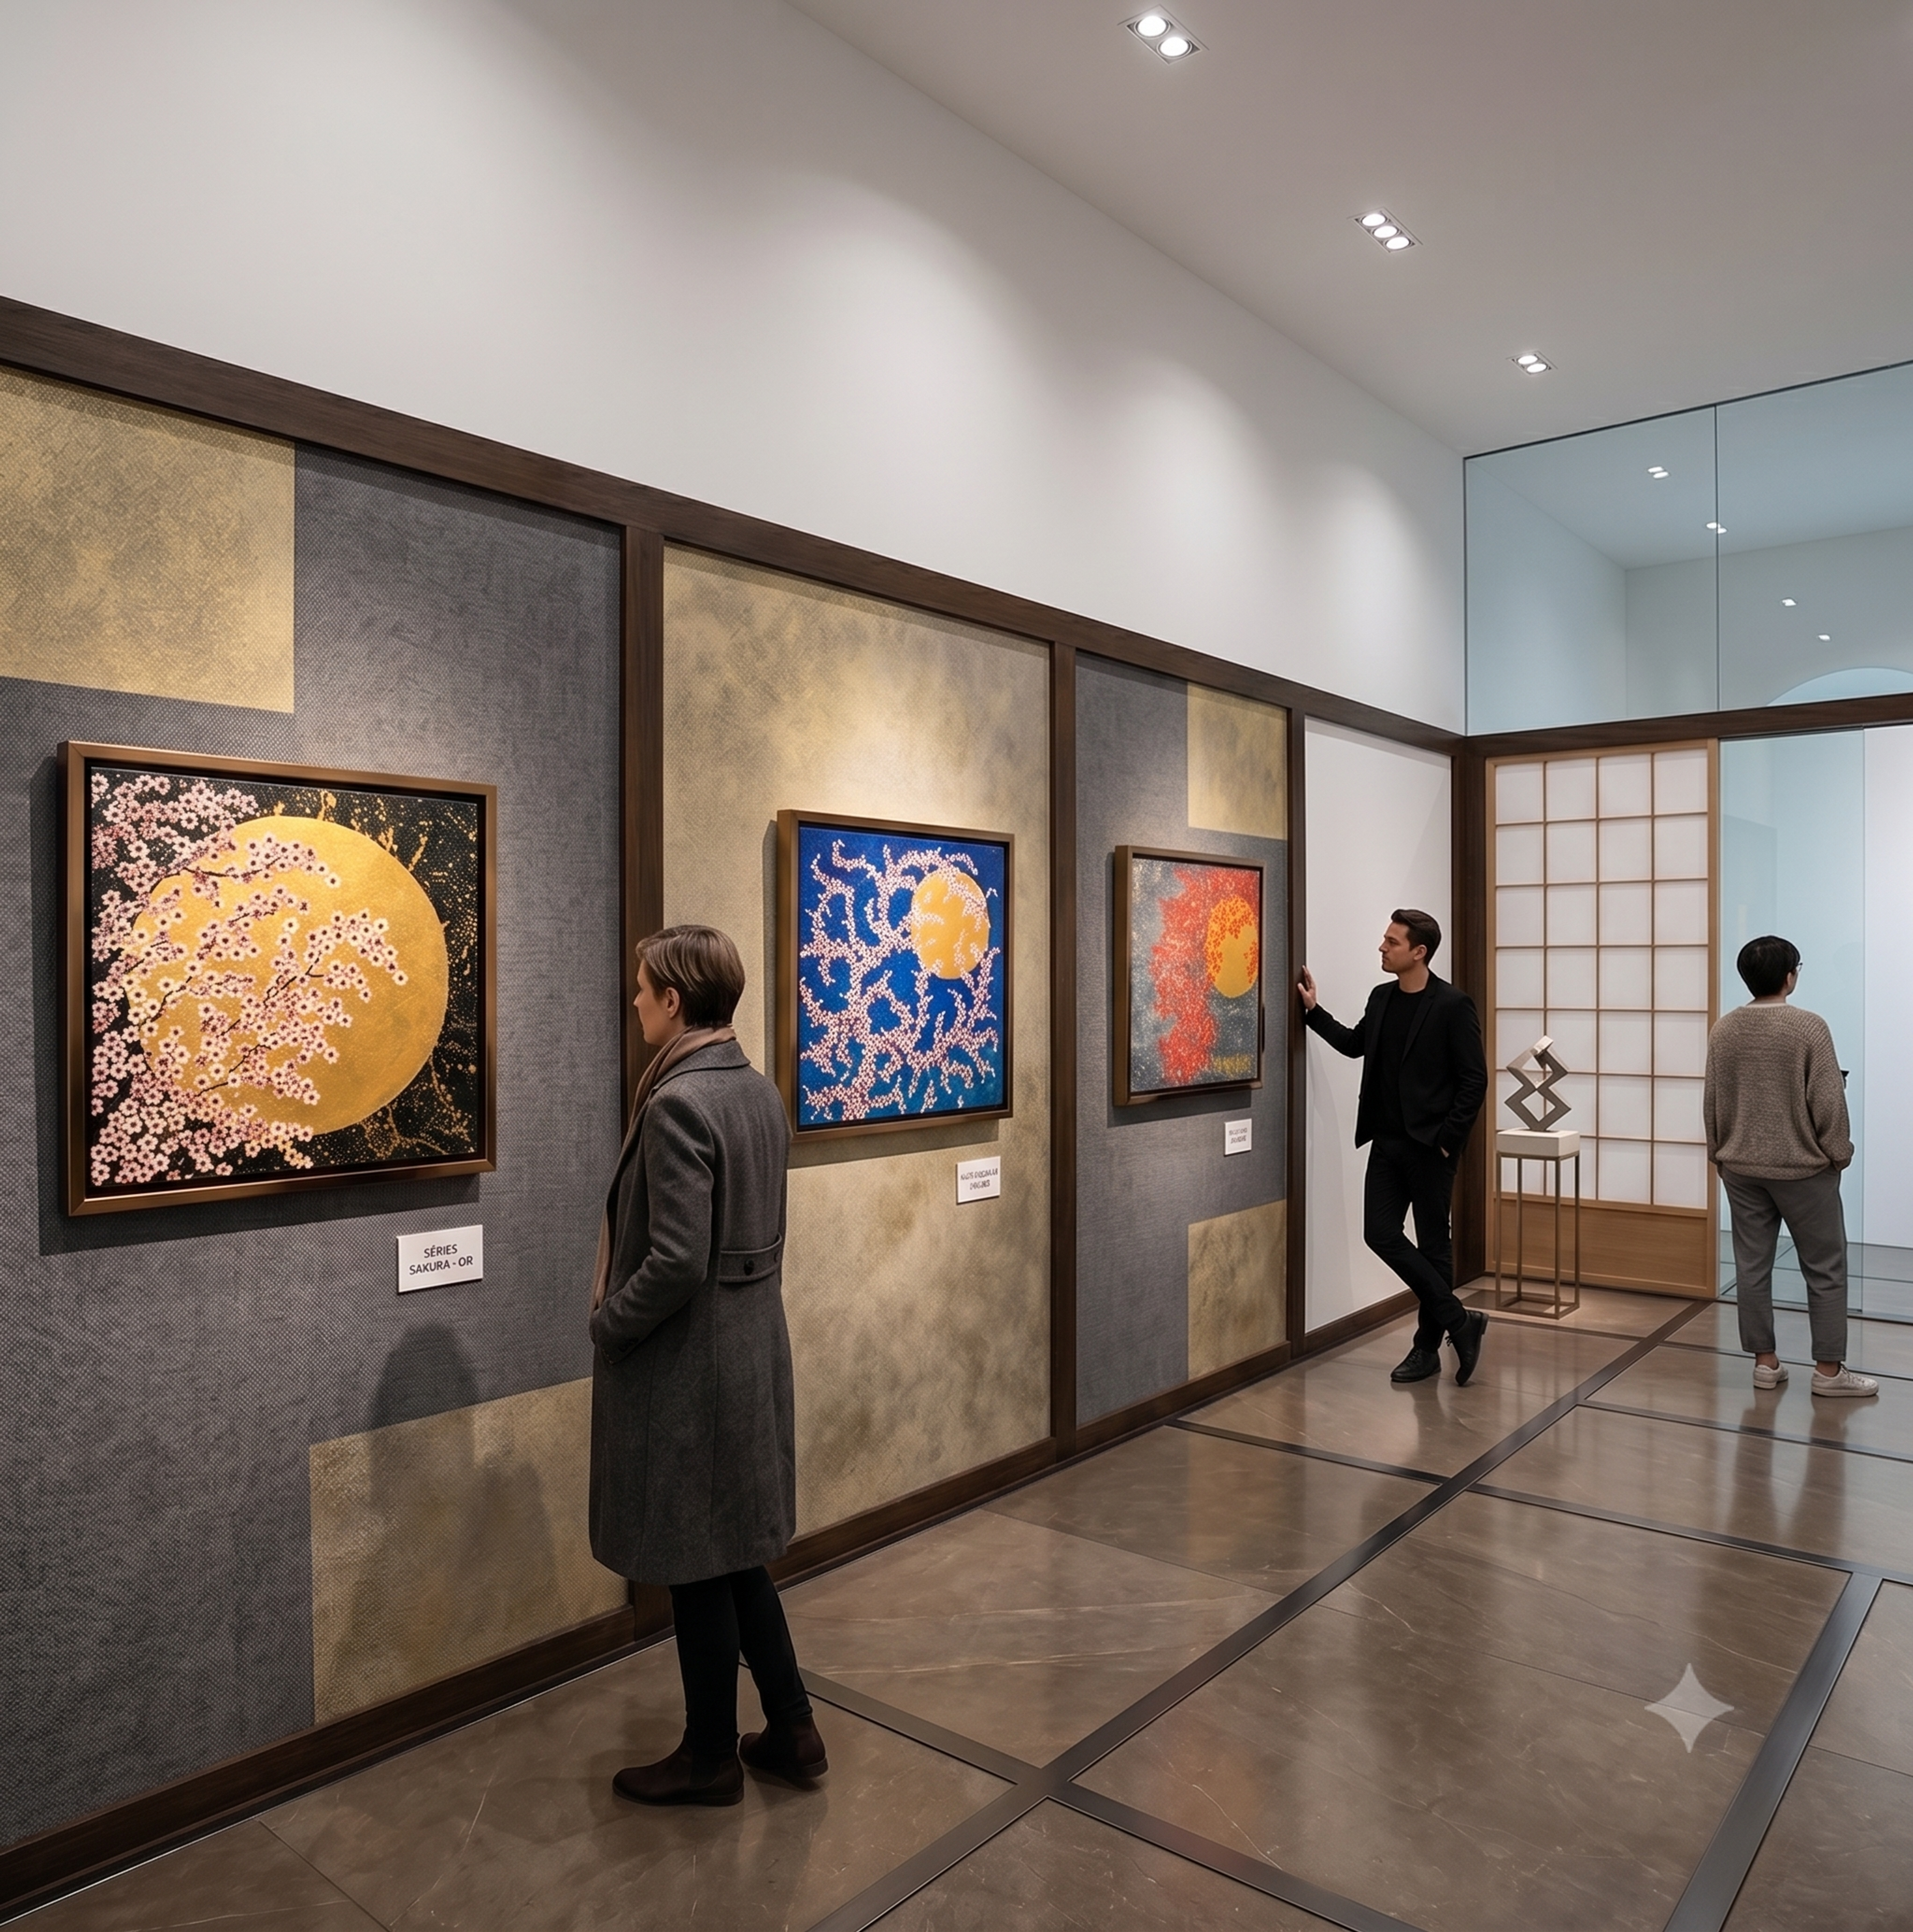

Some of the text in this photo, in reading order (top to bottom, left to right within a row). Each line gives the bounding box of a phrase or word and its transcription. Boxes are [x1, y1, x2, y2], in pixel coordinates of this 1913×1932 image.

[424, 1244, 458, 1258] SÉRIES
[410, 1259, 450, 1275] SAKURA
[458, 1255, 473, 1267] OR
